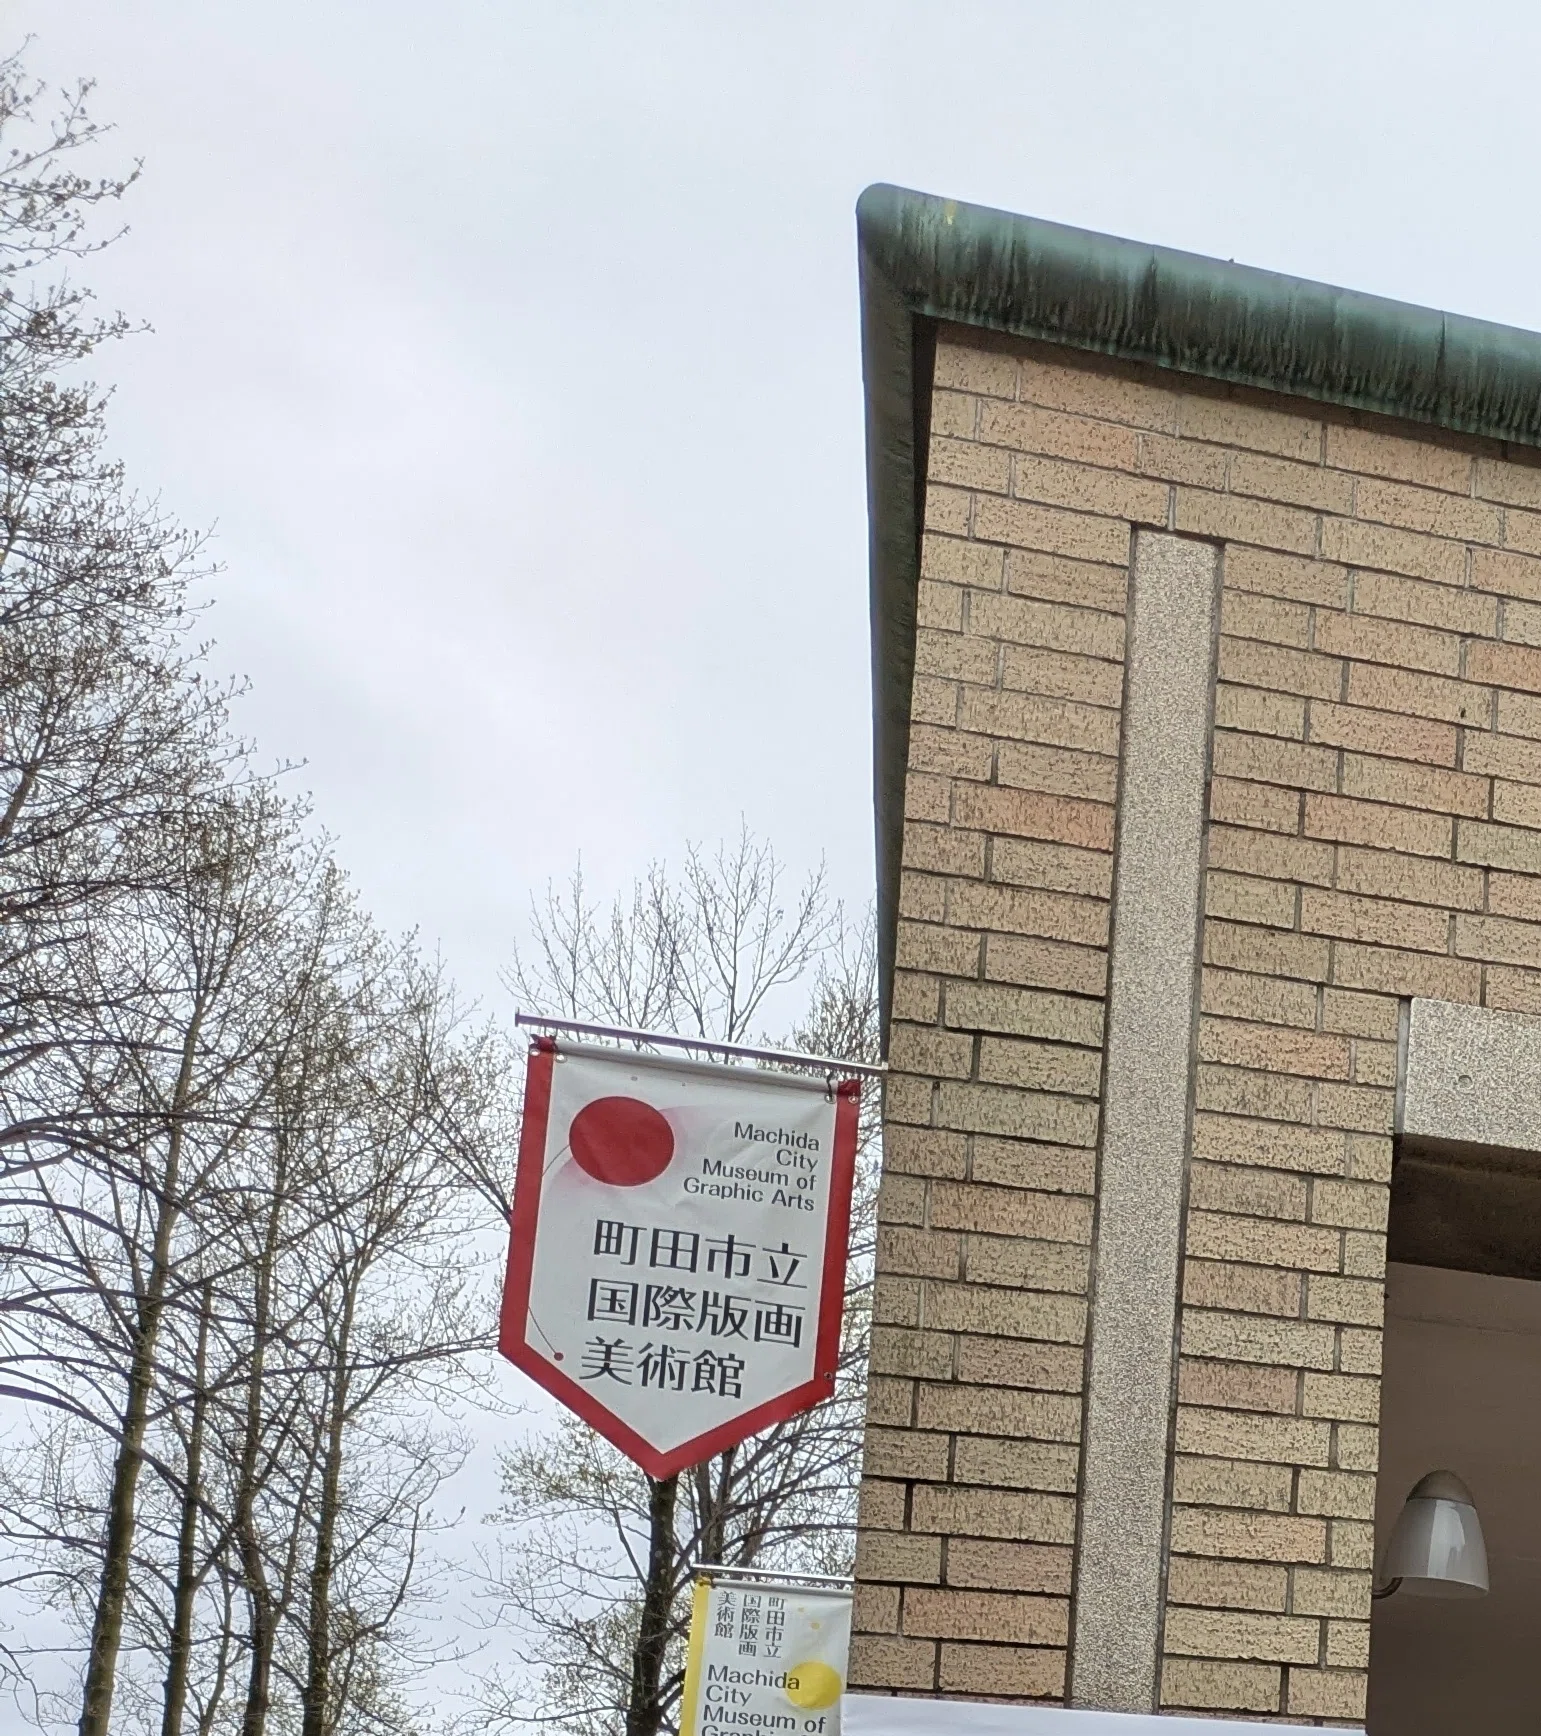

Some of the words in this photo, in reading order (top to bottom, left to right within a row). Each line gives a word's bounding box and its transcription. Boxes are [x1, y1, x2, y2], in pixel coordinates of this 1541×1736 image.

[734, 1121, 820, 1152] Machida
[702, 1157, 789, 1187] Museum
[796, 1173, 818, 1192] of
[776, 1149, 819, 1173] City
[683, 1176, 764, 1204] Graphic
[771, 1188, 816, 1212] Arts
[593, 1219, 808, 1290] 町田市立
[586, 1277, 806, 1349] 国際版画
[578, 1336, 746, 1400] 美術館
[714, 1590, 738, 1640] 美術館
[738, 1593, 762, 1657] 国際版画
[763, 1597, 786, 1659] 町田市立
[705, 1684, 753, 1707] City
[707, 1664, 801, 1691] Machida
[702, 1704, 796, 1731] Museum
[804, 1716, 827, 1734] of
